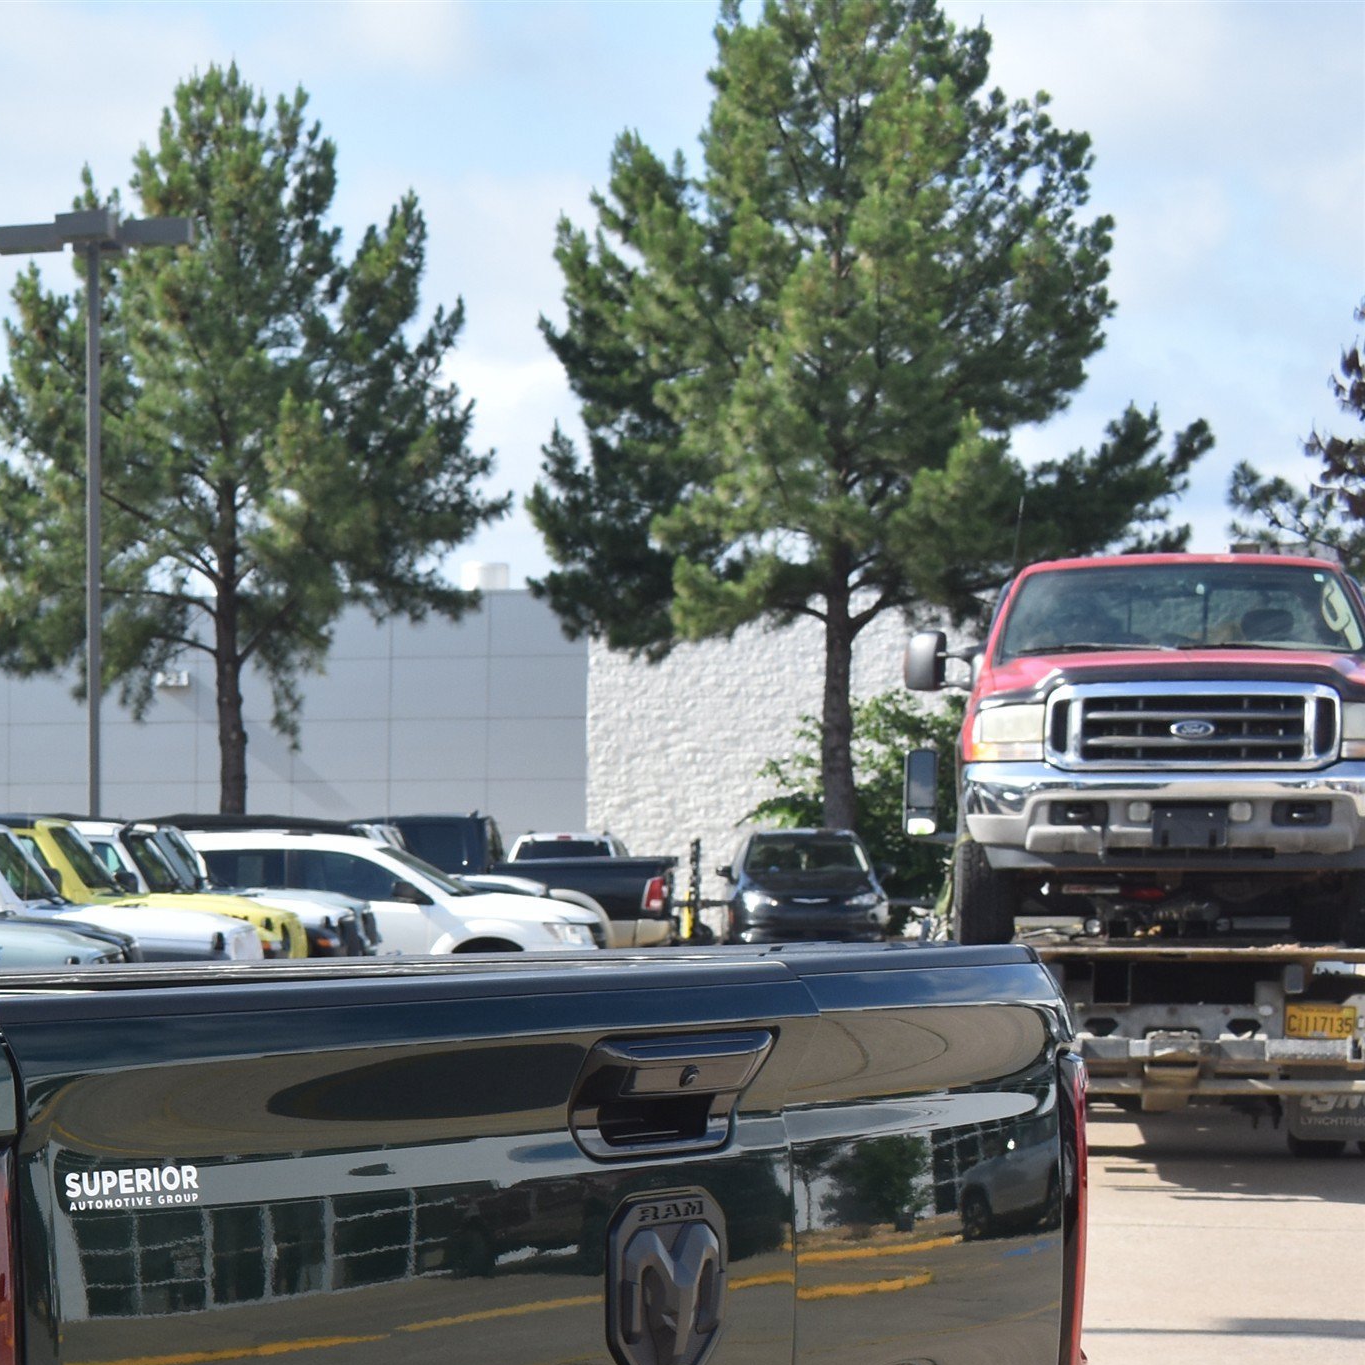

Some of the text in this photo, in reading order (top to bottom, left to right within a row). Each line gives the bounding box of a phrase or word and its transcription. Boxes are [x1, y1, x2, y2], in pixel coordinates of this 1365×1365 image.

[65, 1165, 199, 1198] SUPERIOR
[69, 1193, 199, 1212] AUTOMOTIVE GROUP
[638, 1200, 704, 1222] RAM
